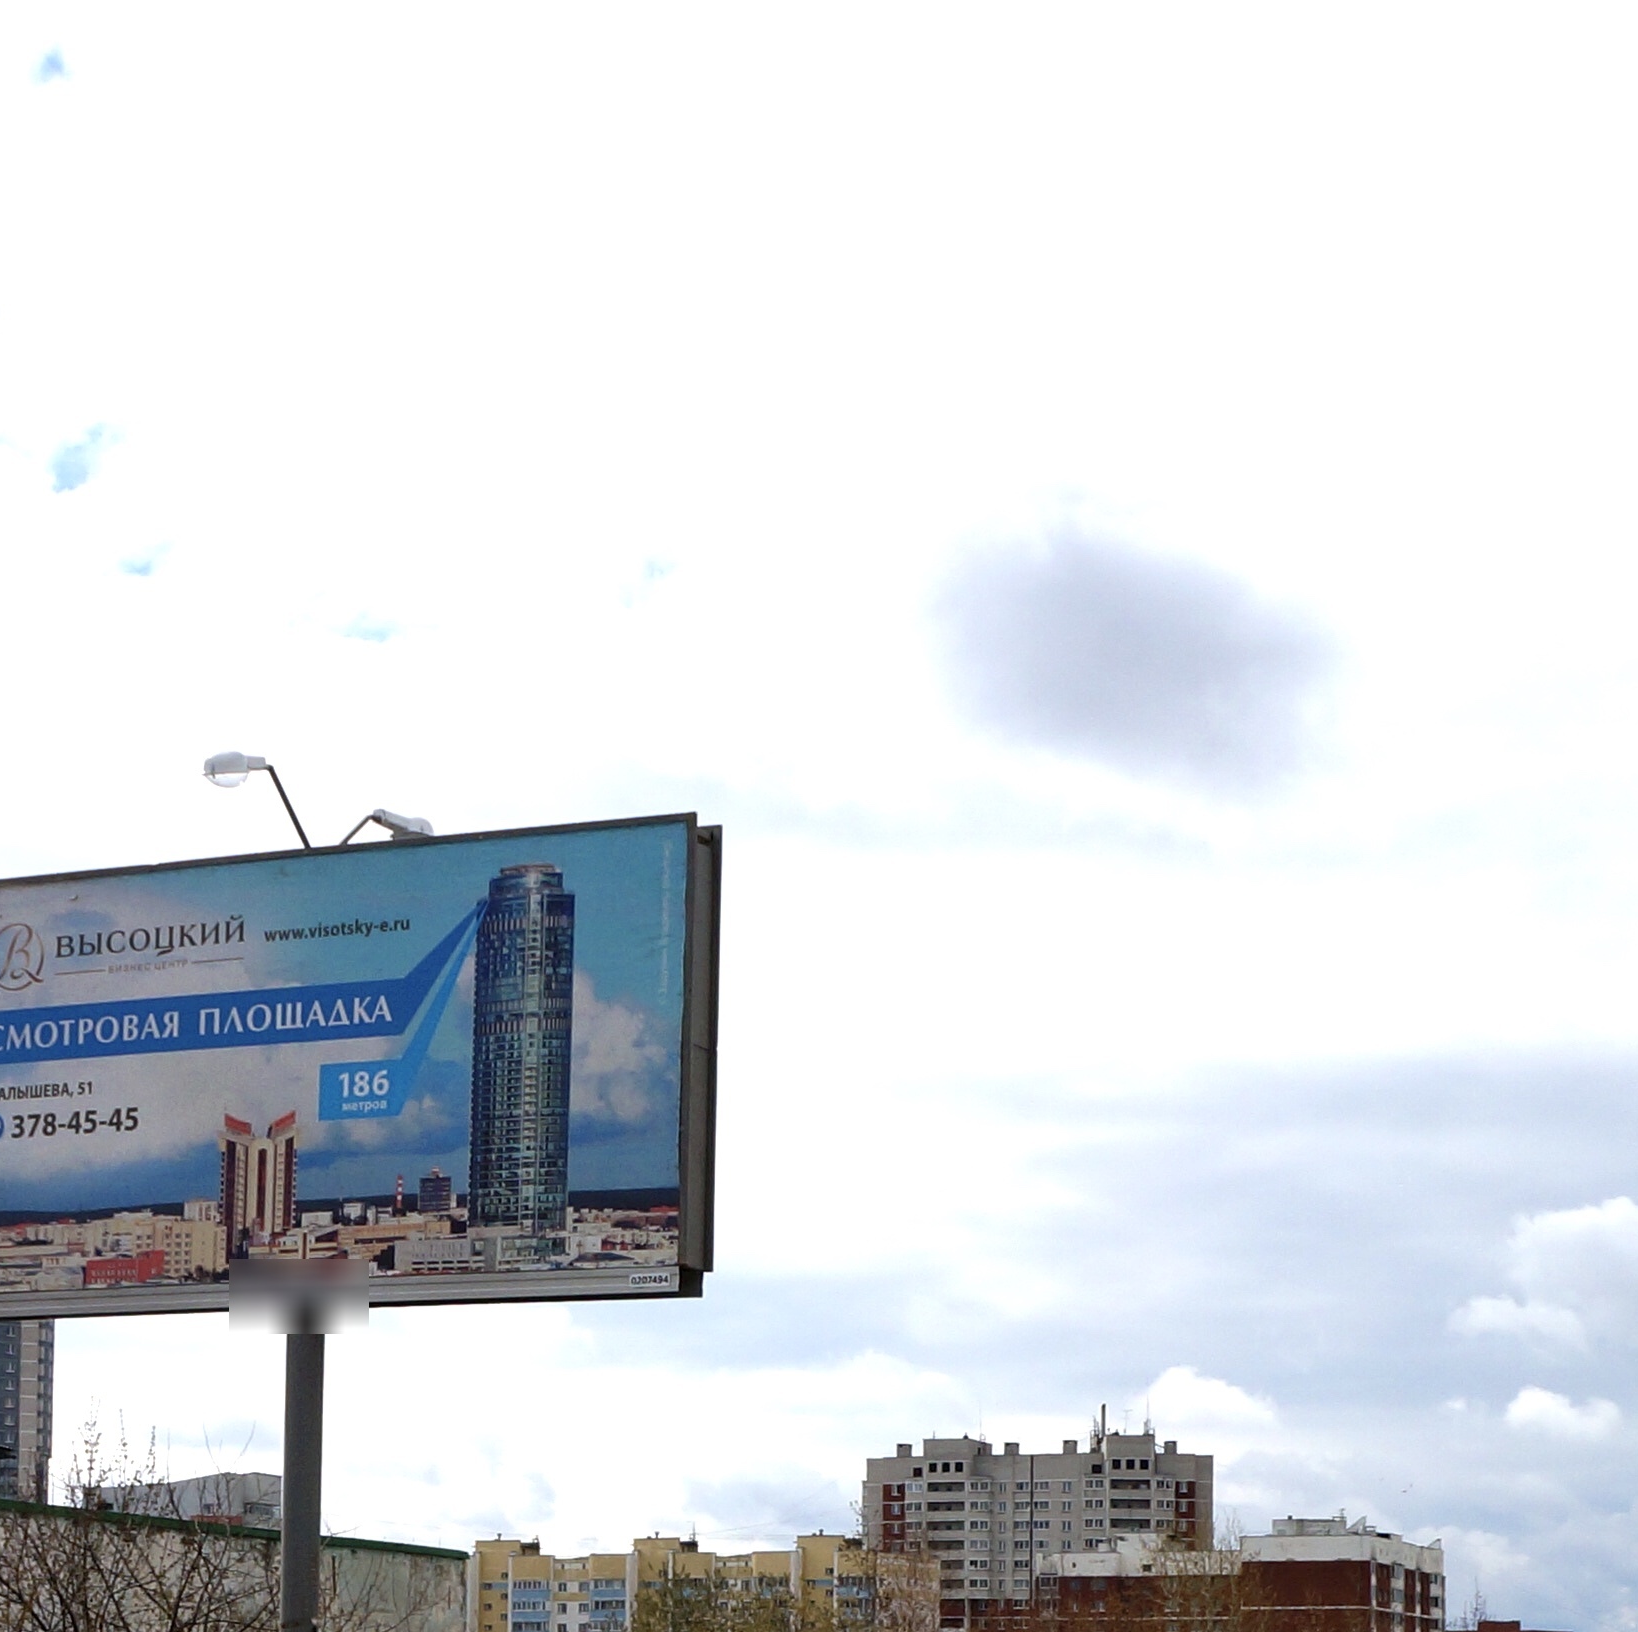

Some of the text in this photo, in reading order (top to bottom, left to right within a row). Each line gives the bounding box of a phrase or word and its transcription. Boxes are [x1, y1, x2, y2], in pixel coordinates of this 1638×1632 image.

[54, 914, 246, 958] ВЫСОЦКИЙ
[264, 918, 411, 943] www.visotsky-e.ru
[107, 958, 189, 975] БИЗНЕС ЦЕНТР
[198, 995, 394, 1037] ПЛОЩАДКА
[78, 1080, 94, 1096] 51
[338, 1069, 391, 1098] 186
[341, 1099, 388, 1113] метров
[10, 1106, 139, 1139] 378-45-45
